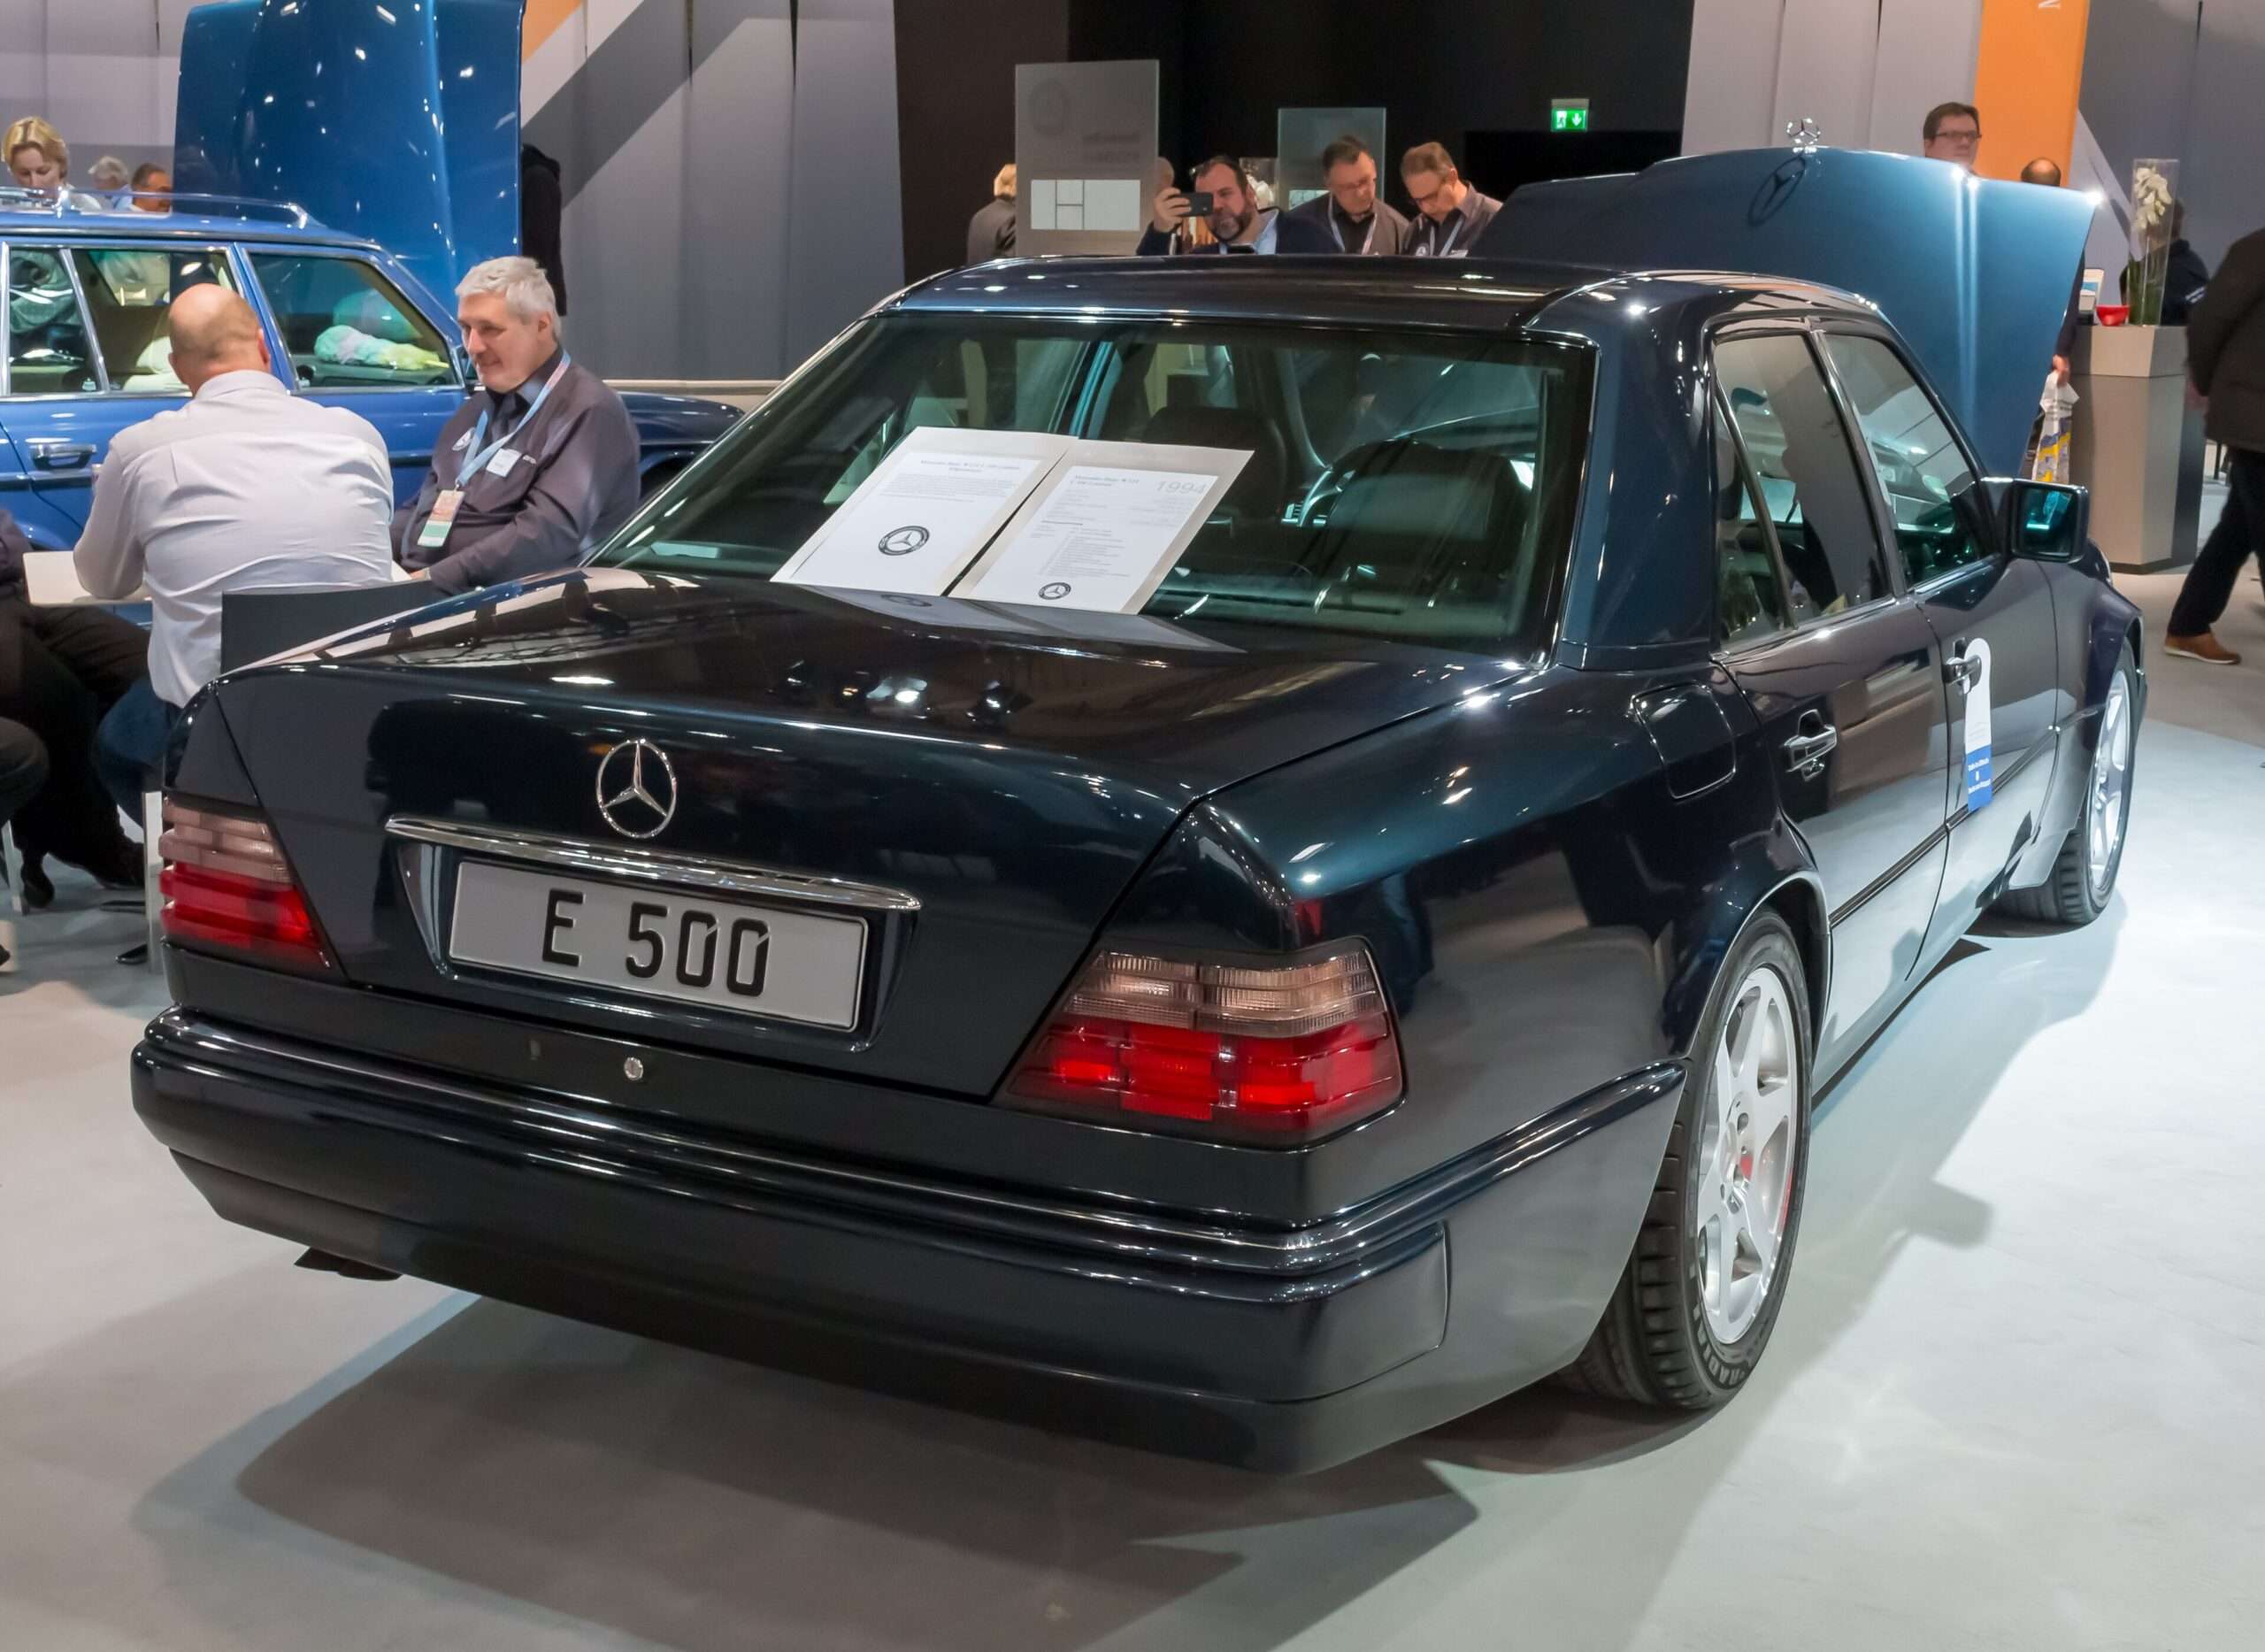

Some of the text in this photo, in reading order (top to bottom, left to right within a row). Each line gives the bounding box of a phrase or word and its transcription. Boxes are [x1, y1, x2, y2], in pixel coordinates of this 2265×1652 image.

[1156, 480, 1207, 496] 1994
[541, 887, 771, 997] E 500
